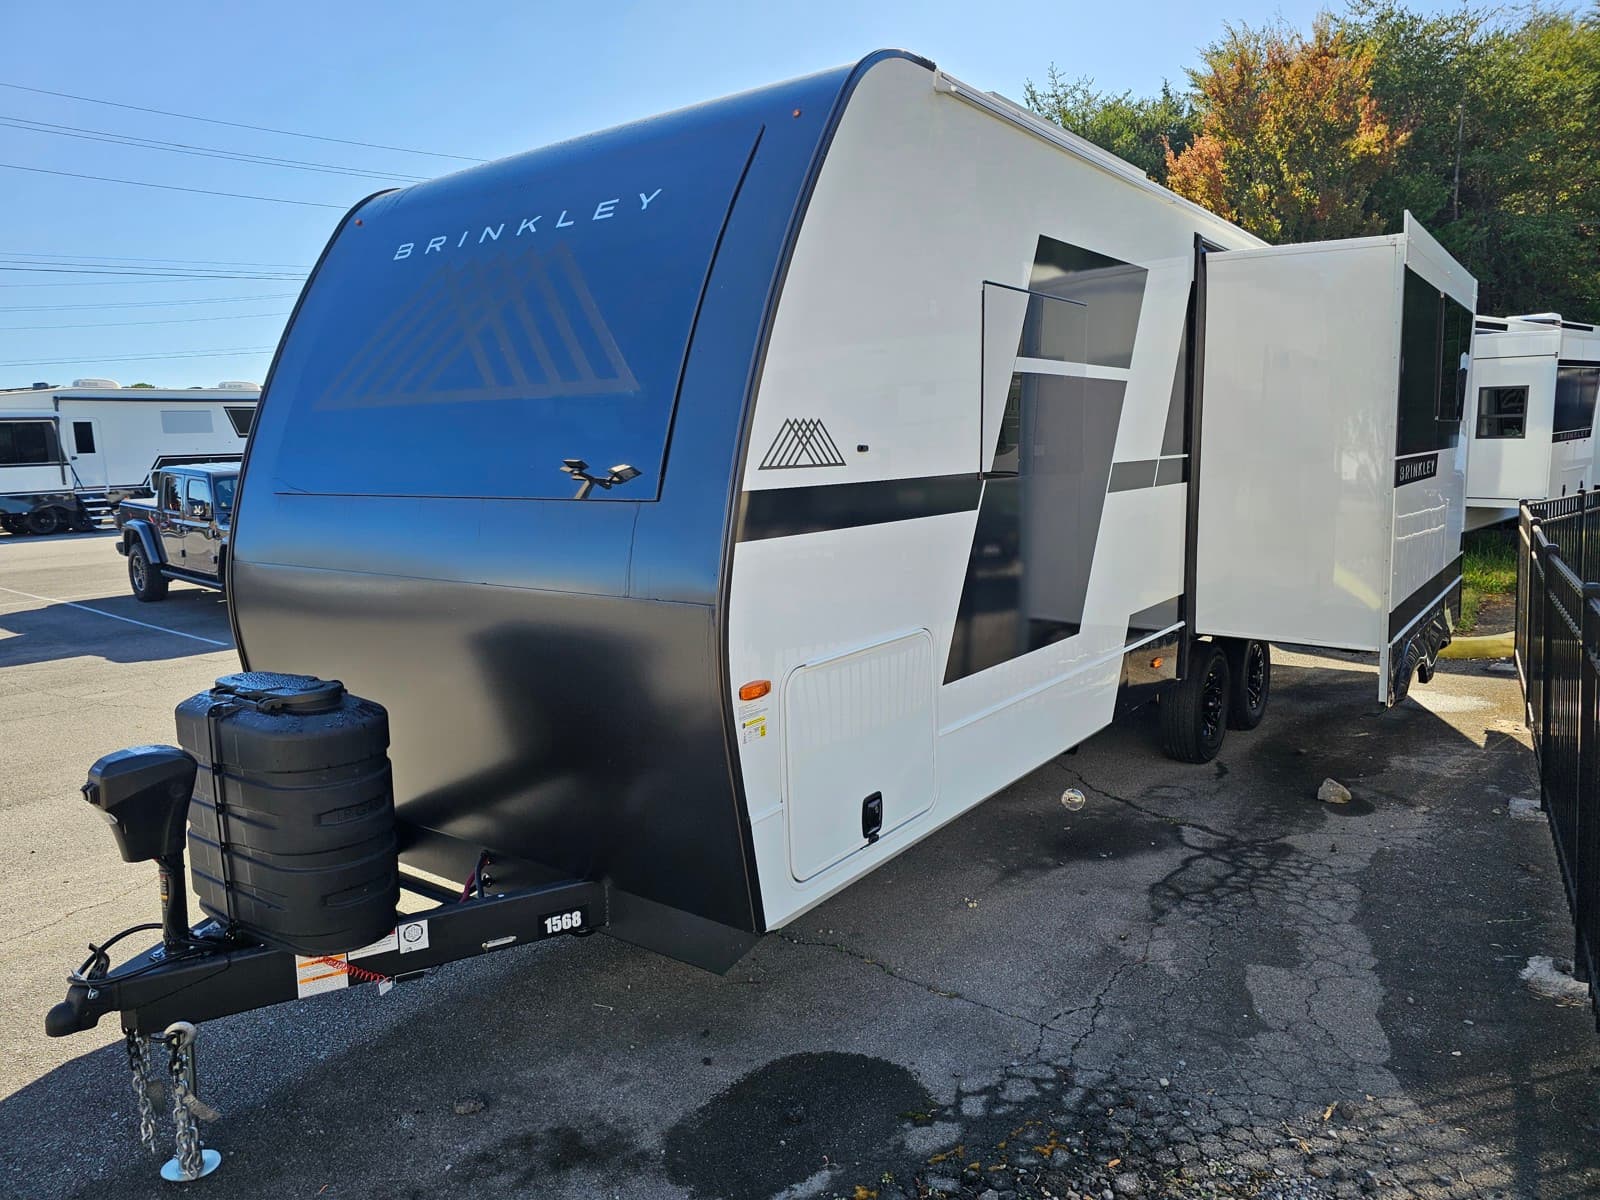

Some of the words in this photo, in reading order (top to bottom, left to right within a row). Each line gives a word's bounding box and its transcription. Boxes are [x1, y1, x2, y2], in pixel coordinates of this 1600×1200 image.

[393, 188, 662, 261] BRINKLEY
[1399, 460, 1435, 481] BRINKLEY
[544, 910, 582, 934] 1568
